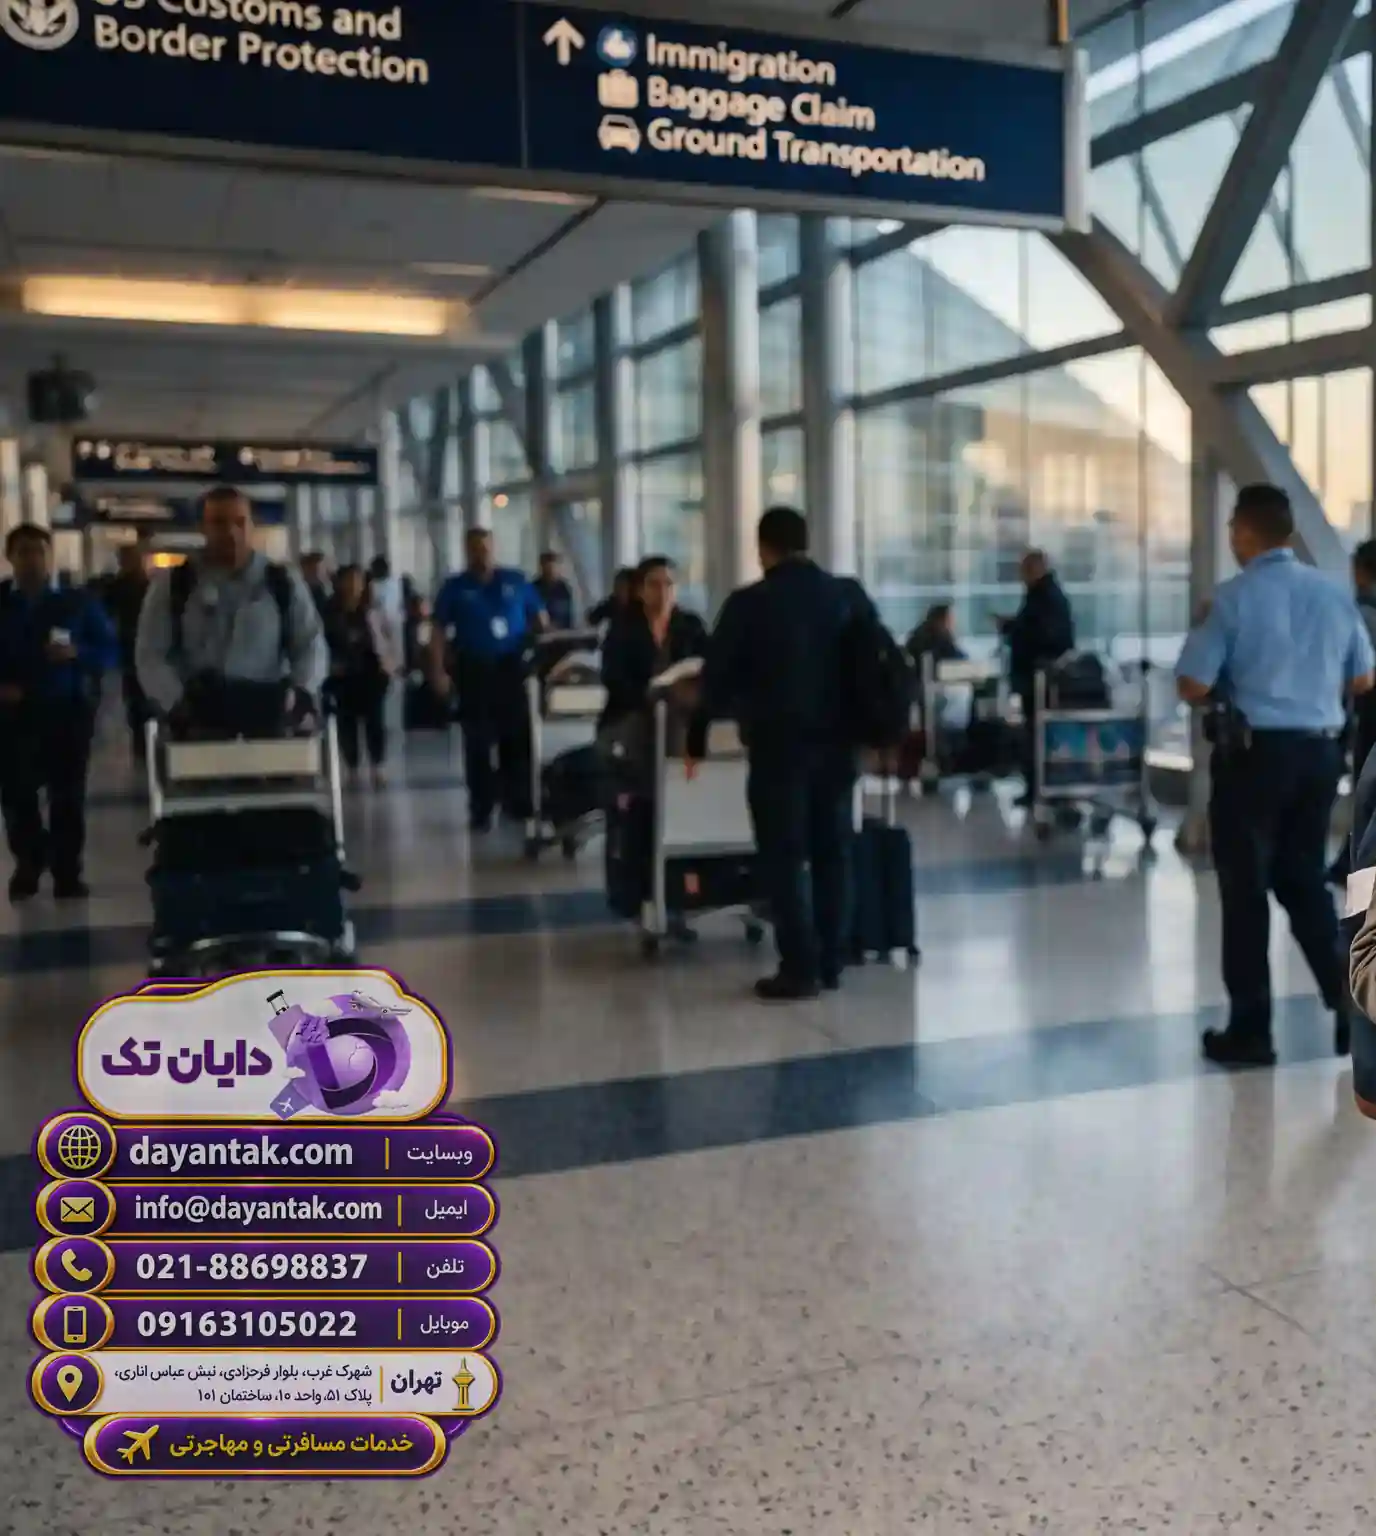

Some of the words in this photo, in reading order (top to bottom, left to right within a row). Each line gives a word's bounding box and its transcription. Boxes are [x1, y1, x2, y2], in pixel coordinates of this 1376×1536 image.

[93, 14, 228, 62] Border
[238, 32, 429, 84] Protection
[332, 6, 401, 41] and
[646, 33, 836, 86] Immigration
[647, 75, 786, 126] Baggage
[791, 93, 876, 131] Claim
[647, 118, 767, 161] Ground
[771, 130, 985, 182] Transportation
